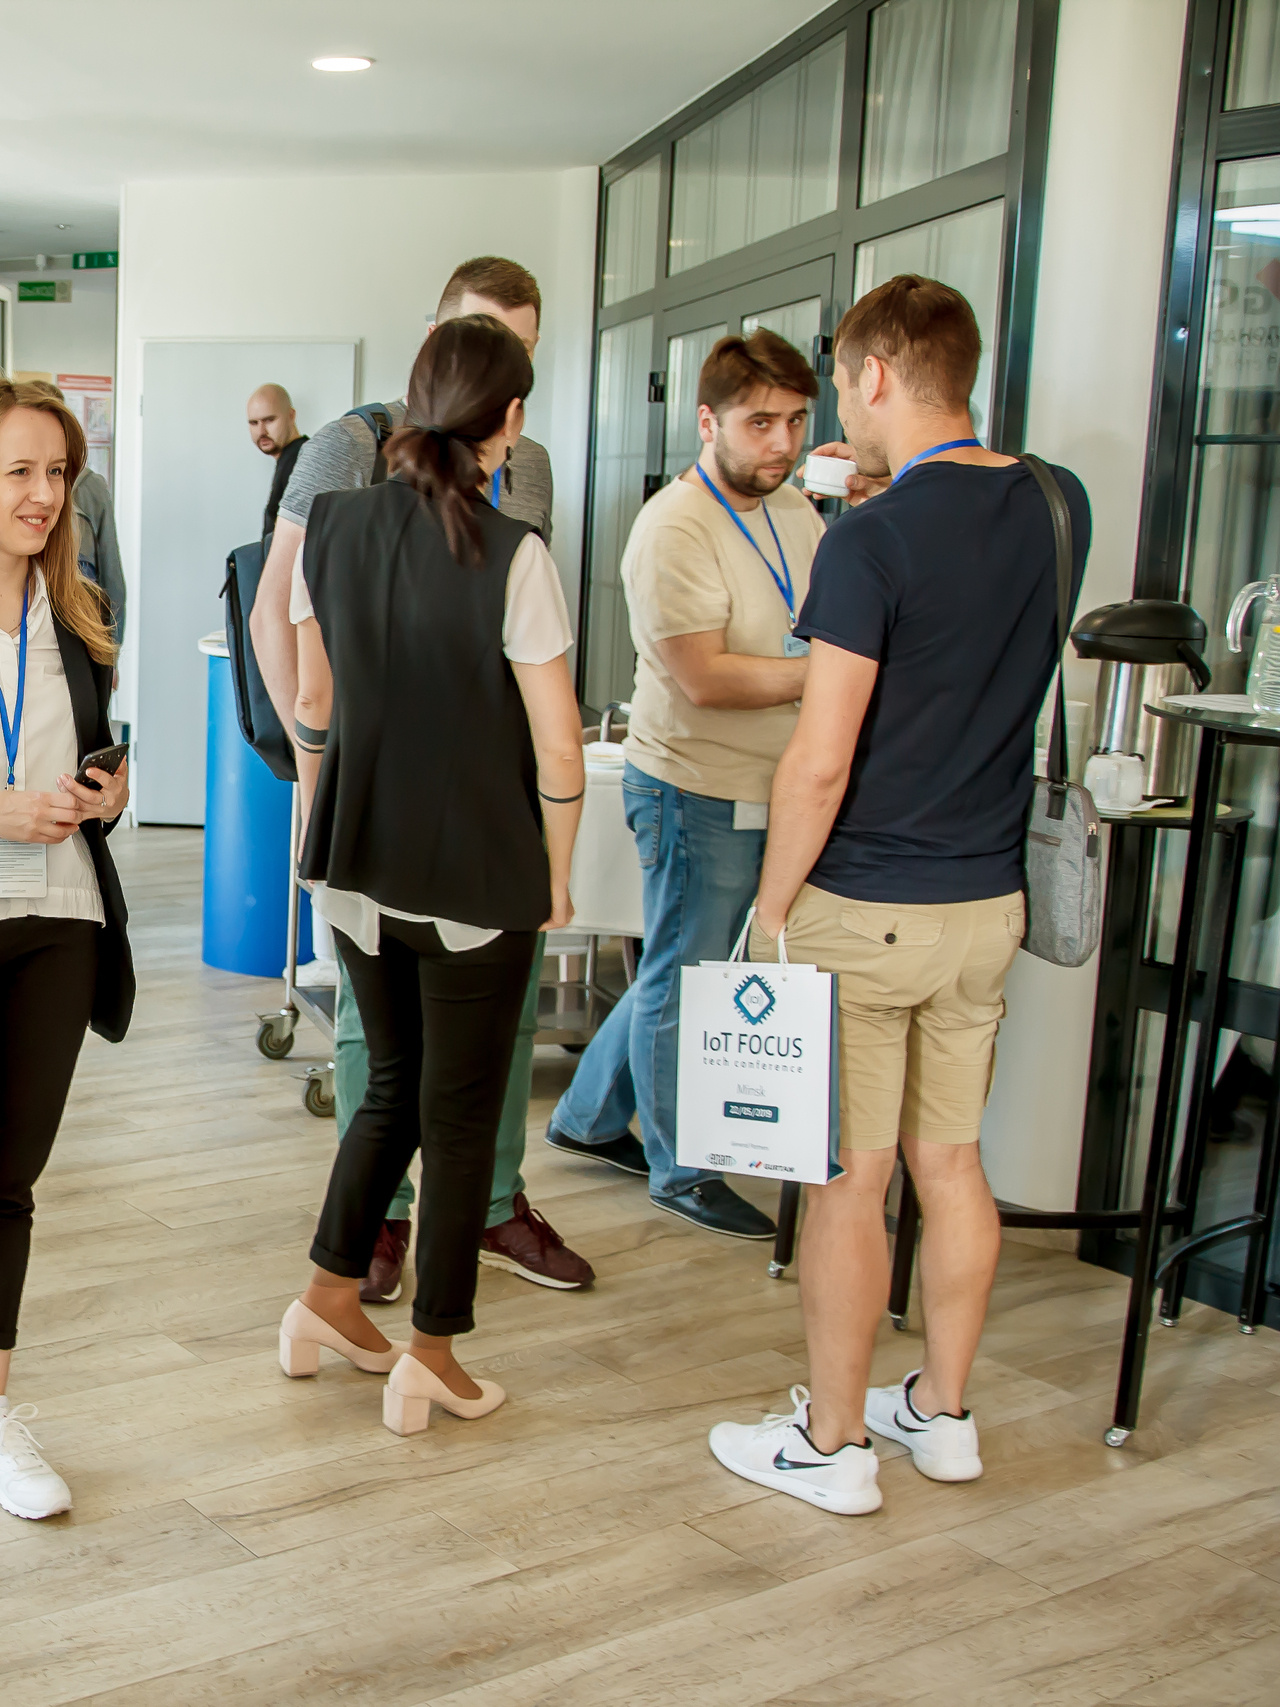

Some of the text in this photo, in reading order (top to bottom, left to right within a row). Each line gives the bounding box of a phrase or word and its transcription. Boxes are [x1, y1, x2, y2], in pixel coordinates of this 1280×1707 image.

[703, 1030, 803, 1059] IoT FOCUS
[702, 1056, 804, 1074] tech conference
[736, 1083, 767, 1098] Minsk
